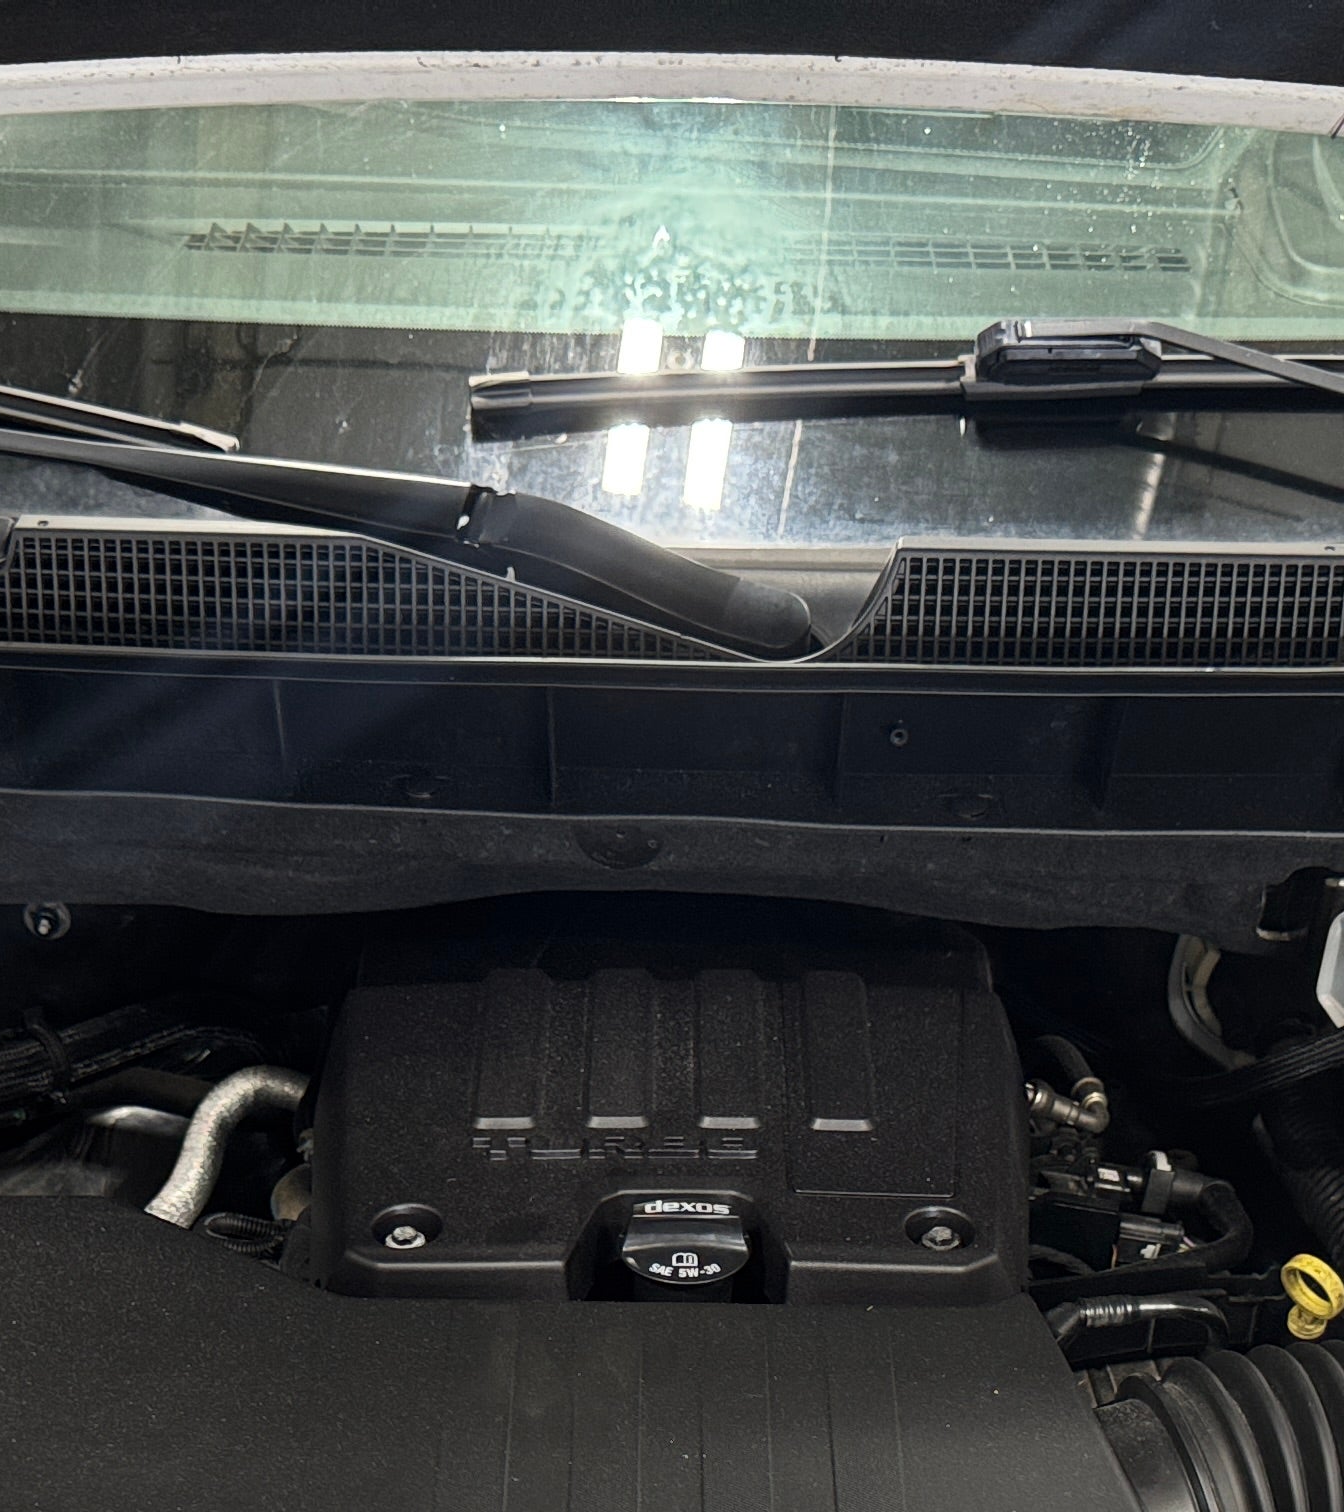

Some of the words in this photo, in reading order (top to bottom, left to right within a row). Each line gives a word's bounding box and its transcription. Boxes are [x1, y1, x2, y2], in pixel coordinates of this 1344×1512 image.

[644, 1200, 730, 1215] dexos
[648, 1262, 674, 1277] SAE
[678, 1263, 722, 1278] 5W-30
